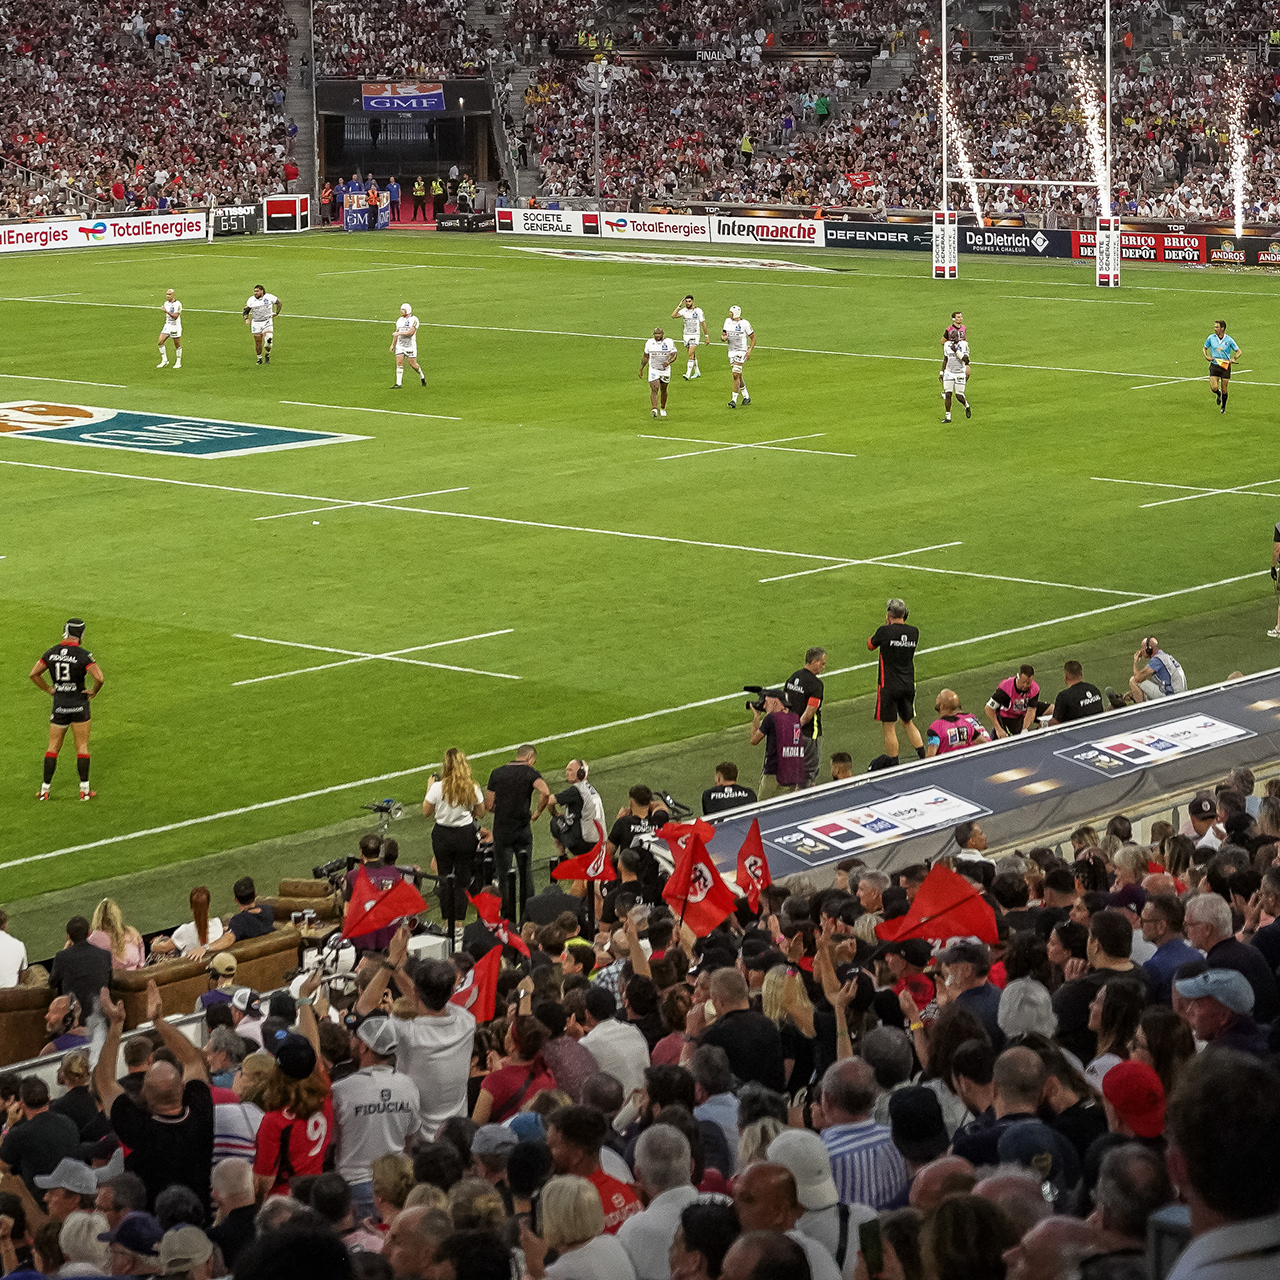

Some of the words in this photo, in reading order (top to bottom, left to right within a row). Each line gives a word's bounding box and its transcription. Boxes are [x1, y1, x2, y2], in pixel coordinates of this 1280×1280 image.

[370, 98, 438, 108] GMF
[224, 206, 256, 216] TISSOT
[523, 212, 563, 223] SOCIETE
[221, 216, 246, 231] 6:57
[347, 213, 369, 226] GM
[110, 217, 202, 238] TotalEnergies
[523, 222, 573, 233] GENERALE
[629, 220, 707, 236] TotalEnergies
[827, 230, 909, 243] DEFENDER
[966, 232, 983, 246] De
[984, 232, 1031, 247] Dietrich
[1121, 235, 1156, 247] BRICO
[1164, 237, 1199, 248] BRICO
[1122, 246, 1157, 260] DEPÔT
[1164, 247, 1200, 261] DEPÔT
[1212, 250, 1245, 261] ANDROS
[54, 662, 71, 681] 13
[354, 1101, 412, 1117] FIDUCIAL
[306, 1111, 328, 1157] 9
